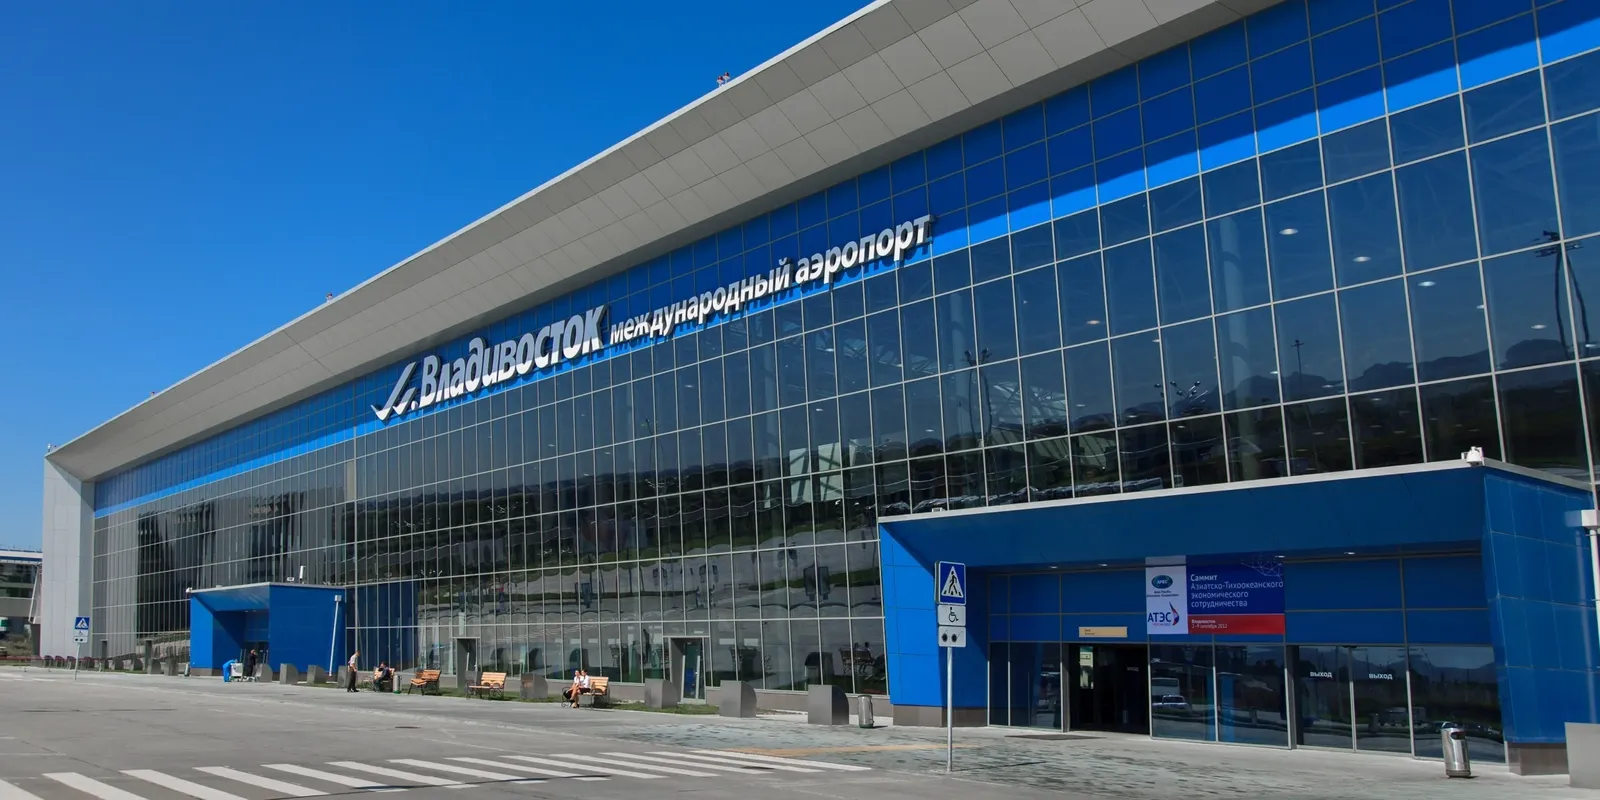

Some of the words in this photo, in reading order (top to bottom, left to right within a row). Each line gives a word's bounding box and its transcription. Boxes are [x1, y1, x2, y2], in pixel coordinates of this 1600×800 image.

[418, 304, 608, 408] Владивосток
[609, 256, 792, 344] международный
[795, 213, 935, 284] аэропорт
[1190, 573, 1218, 581] Саммит
[1190, 581, 1284, 590] Азиатско-Тихоокеанского
[1190, 591, 1249, 599] экономического
[1191, 600, 1248, 609] сотрудничества
[1147, 612, 1172, 623] АТЭС
